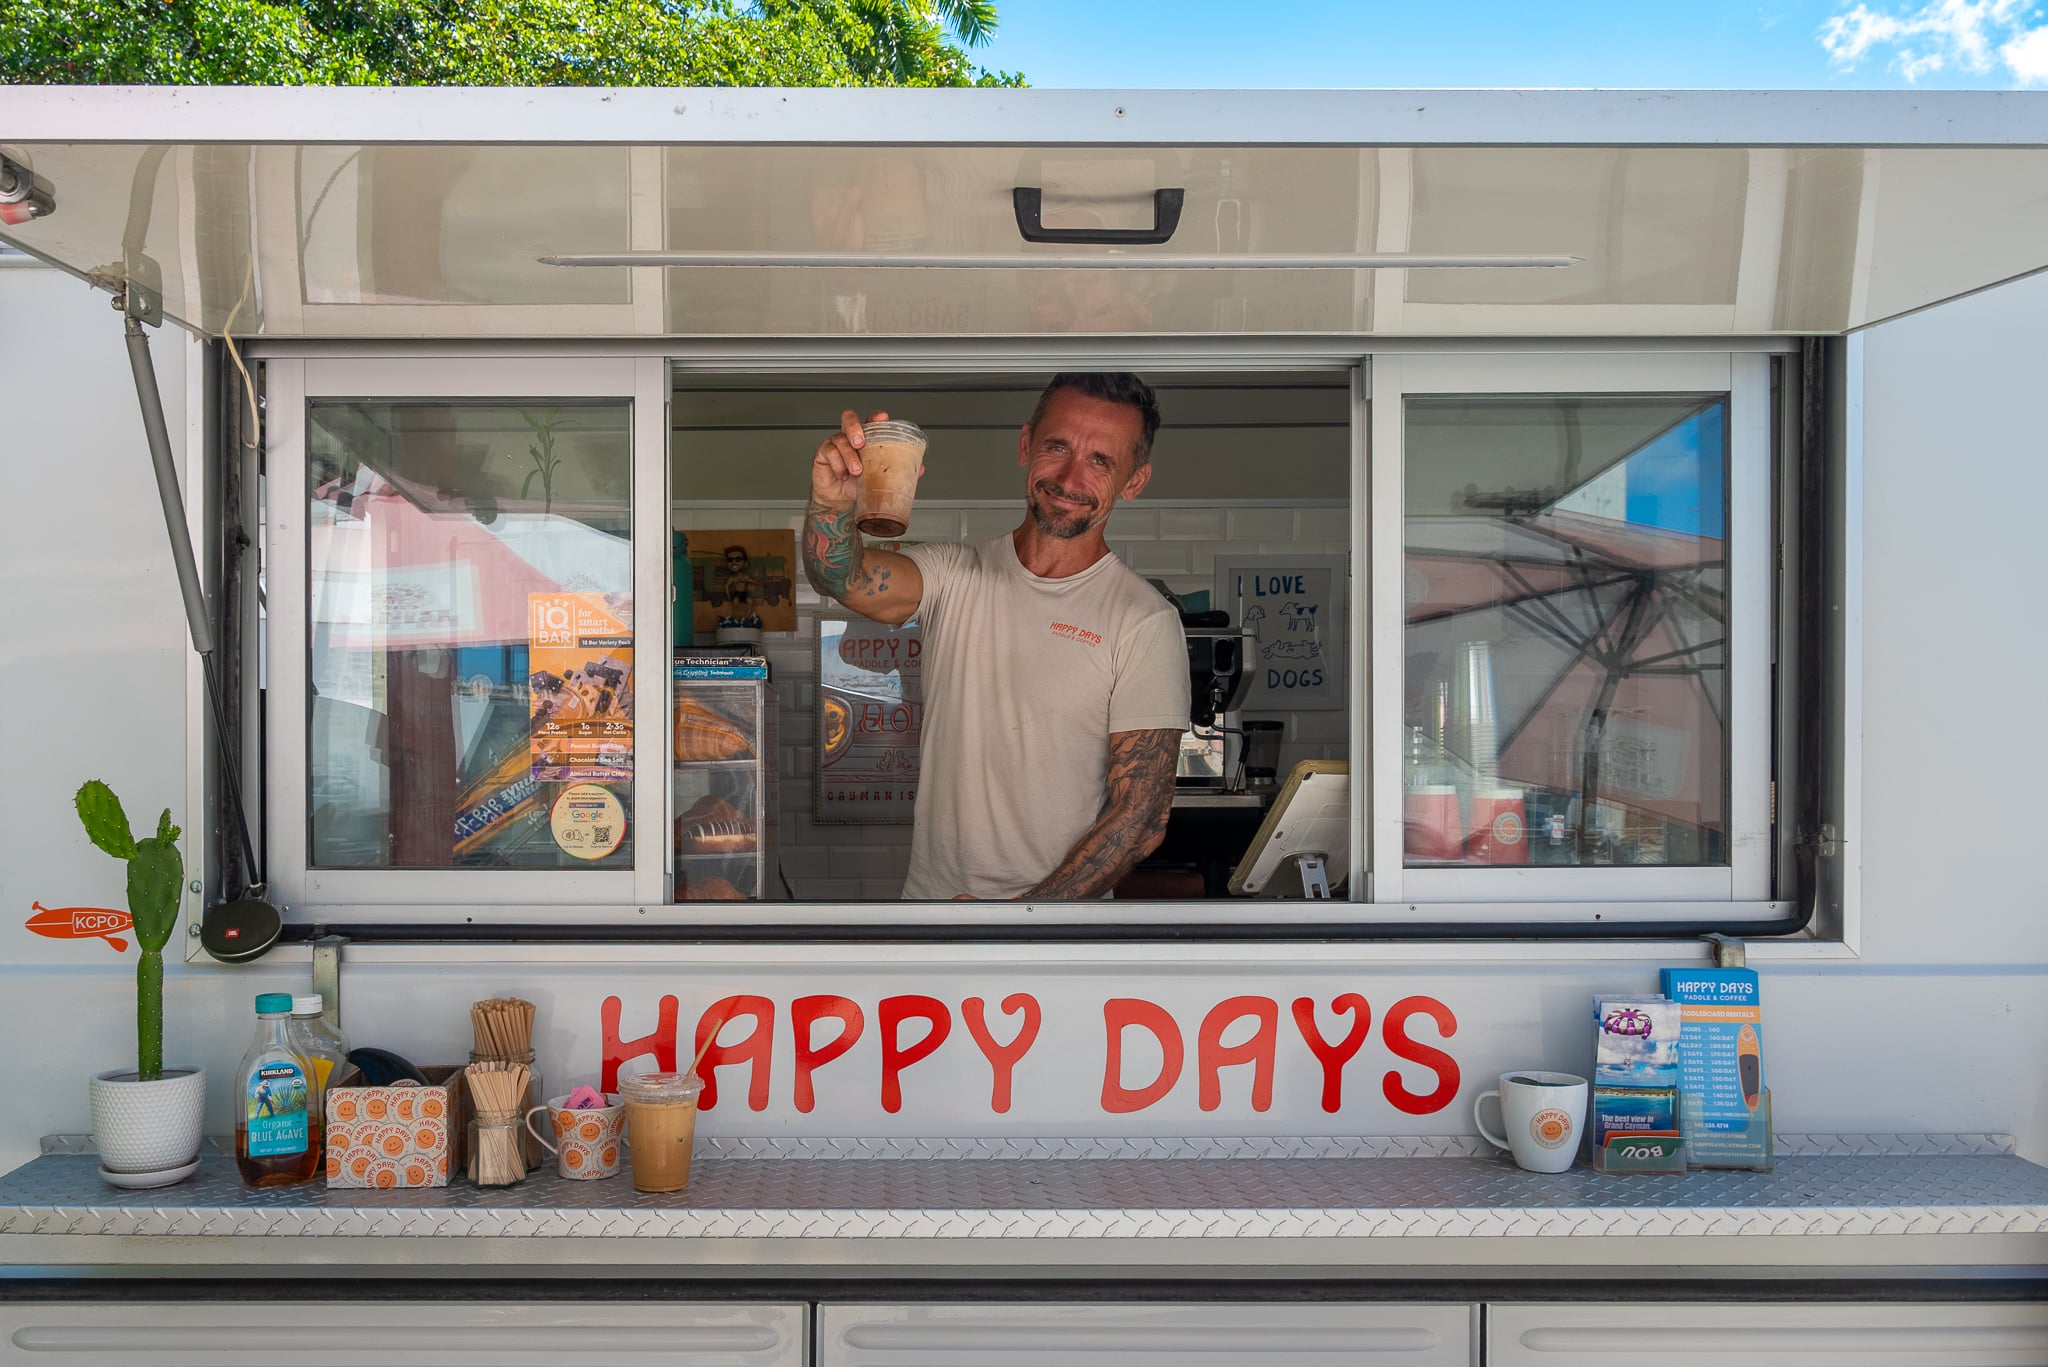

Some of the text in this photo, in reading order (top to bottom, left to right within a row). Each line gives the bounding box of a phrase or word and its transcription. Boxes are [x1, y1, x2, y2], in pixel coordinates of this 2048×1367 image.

[1255, 575, 1306, 597] LOVE
[538, 606, 570, 629] IQ
[578, 608, 592, 617] for
[539, 631, 571, 643] BAR
[1049, 621, 1103, 644] HAPPY DAYS
[1267, 669, 1324, 689] DOGS
[572, 810, 603, 820] Google
[75, 915, 119, 929] KCPO
[1677, 981, 1753, 994] HAPPY DAYS
[600, 993, 1461, 1115] HAPPY DAYS
[261, 1068, 294, 1076] KIRKLAND
[333, 1092, 353, 1104] HAPPY
[362, 1090, 384, 1101] HAPPY
[390, 1091, 409, 1107] HAPPY
[424, 1090, 446, 1100] HAPPY
[262, 1120, 293, 1130] Organic
[576, 1115, 594, 1127] HAPPY
[1536, 1112, 1571, 1131] HAPPY DAYS
[251, 1128, 304, 1142] BLUE AGAVE
[354, 1125, 372, 1141] HAPPY
[376, 1127, 393, 1144] HAPPY
[395, 1127, 411, 1142] DAYS
[420, 1120, 441, 1131] HAPPY
[436, 1132, 444, 1150] DAYS
[574, 1142, 590, 1156] DAYS
[344, 1149, 364, 1164] HAPPY
[377, 1161, 395, 1169] DAYS
[414, 1156, 434, 1172] HAPPY
